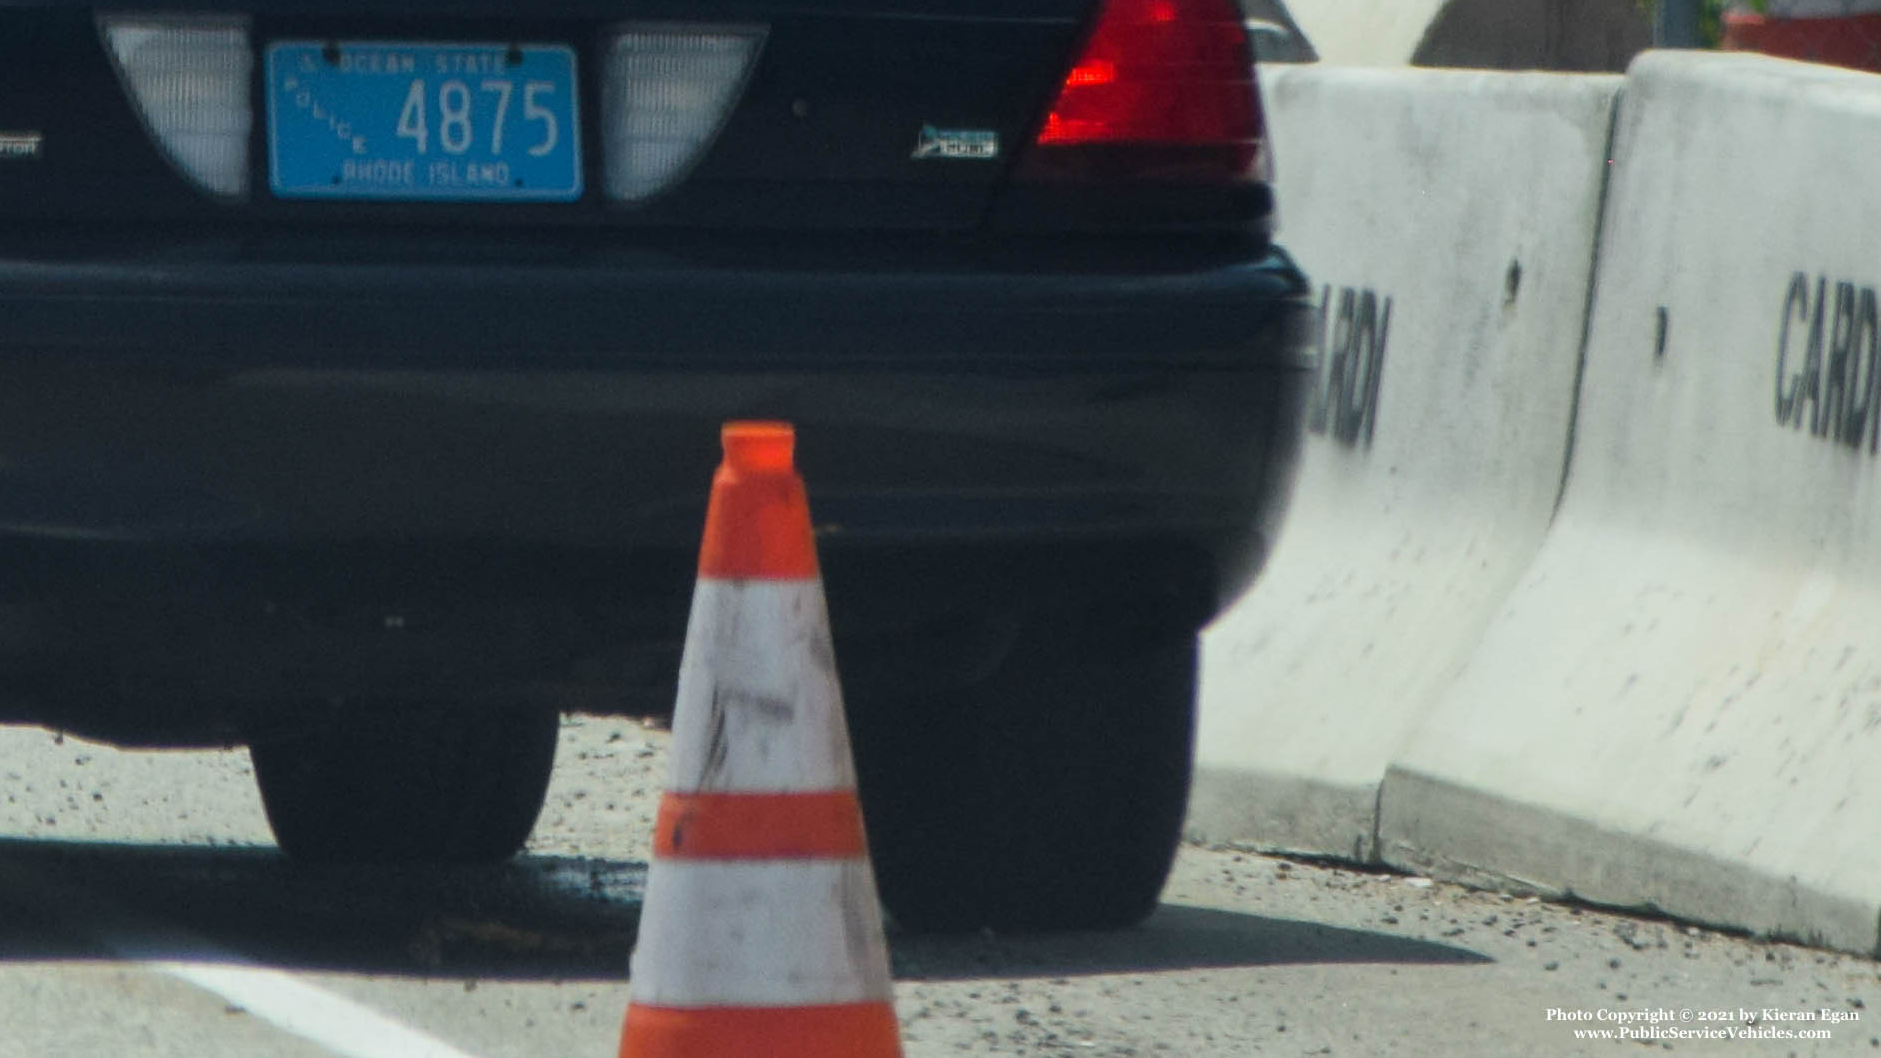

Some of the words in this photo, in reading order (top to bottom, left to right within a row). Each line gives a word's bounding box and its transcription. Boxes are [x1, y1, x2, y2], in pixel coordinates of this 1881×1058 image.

[340, 51, 415, 74] OCEAN
[435, 52, 507, 75] STATE
[284, 77, 367, 155] POLICE
[396, 78, 559, 156] 4875
[341, 158, 415, 184] RHODE
[428, 160, 510, 185] ISLAND
